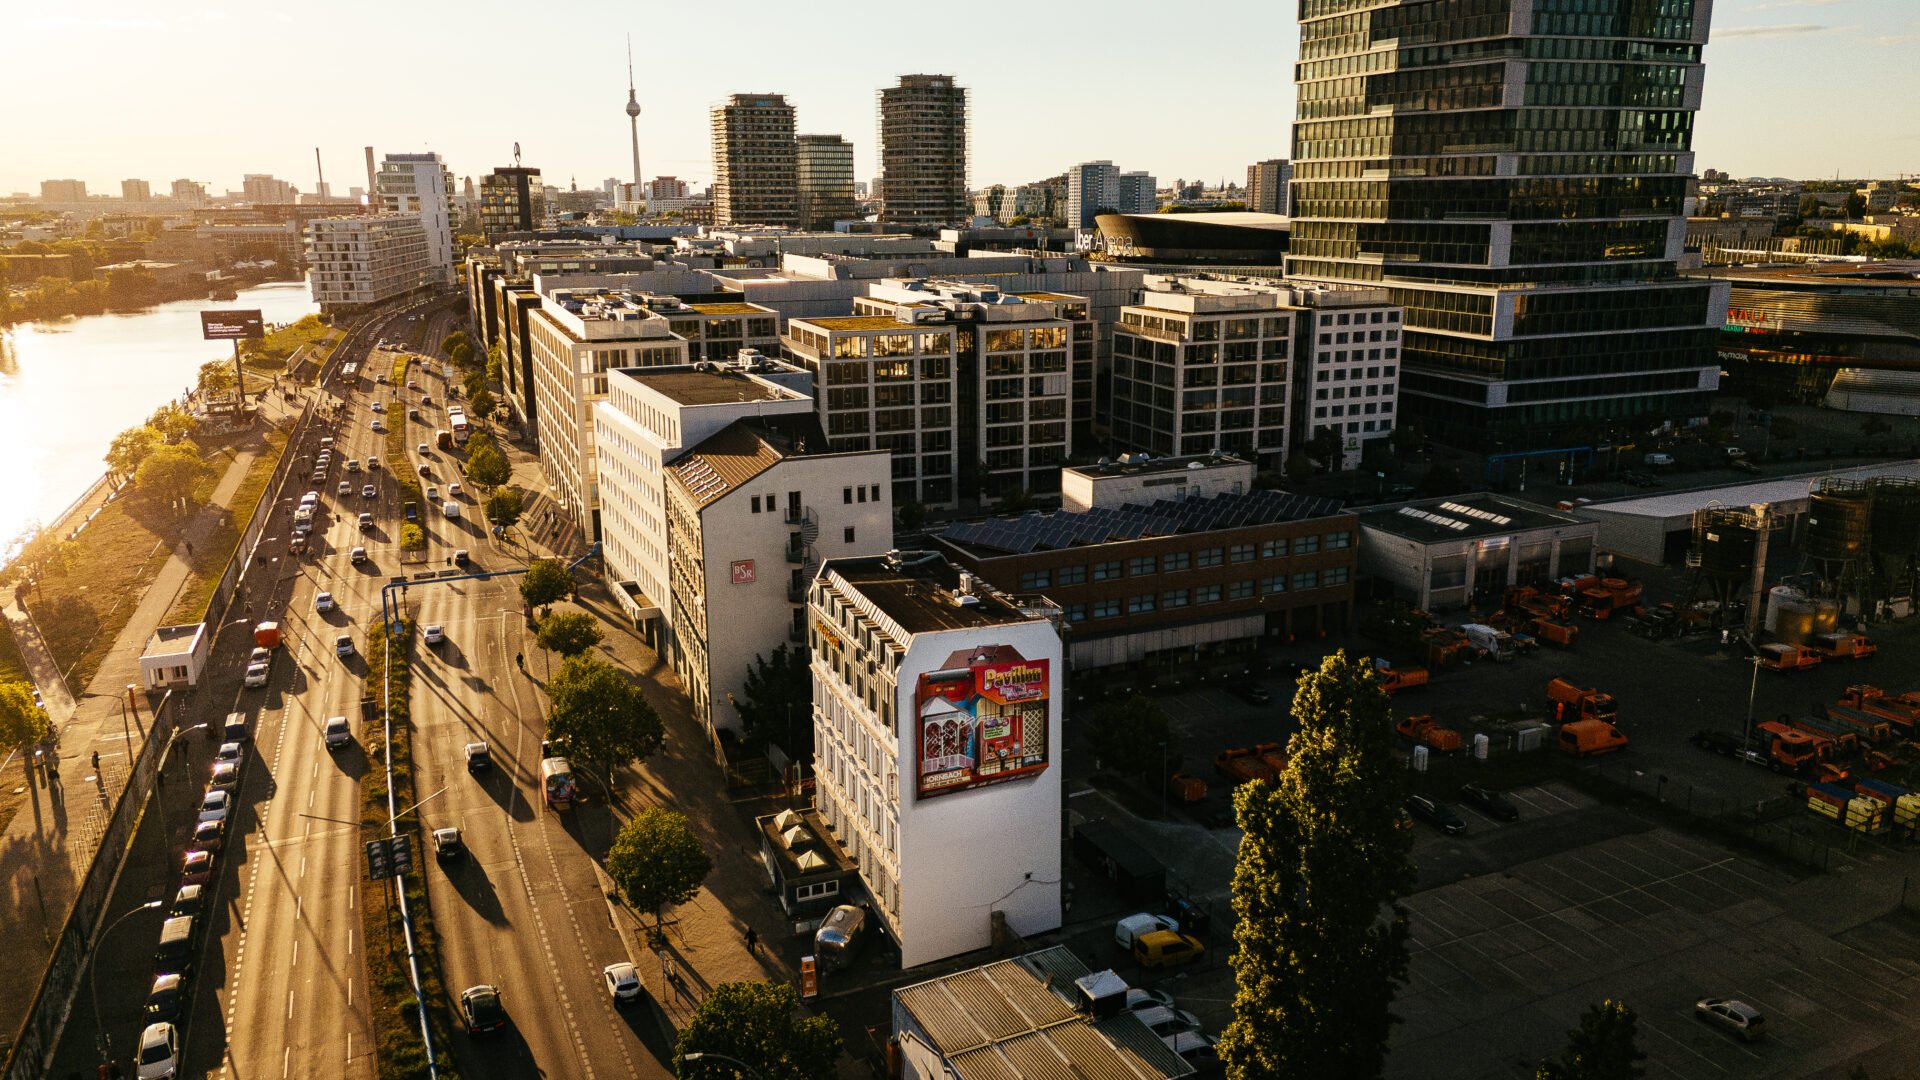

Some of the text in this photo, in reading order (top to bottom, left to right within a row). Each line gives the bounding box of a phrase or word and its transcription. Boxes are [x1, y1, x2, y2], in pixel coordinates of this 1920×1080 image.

[1074, 229, 1133, 252] Uber Arena
[734, 564, 753, 579] BSR
[923, 769, 963, 784] HORNBACH
